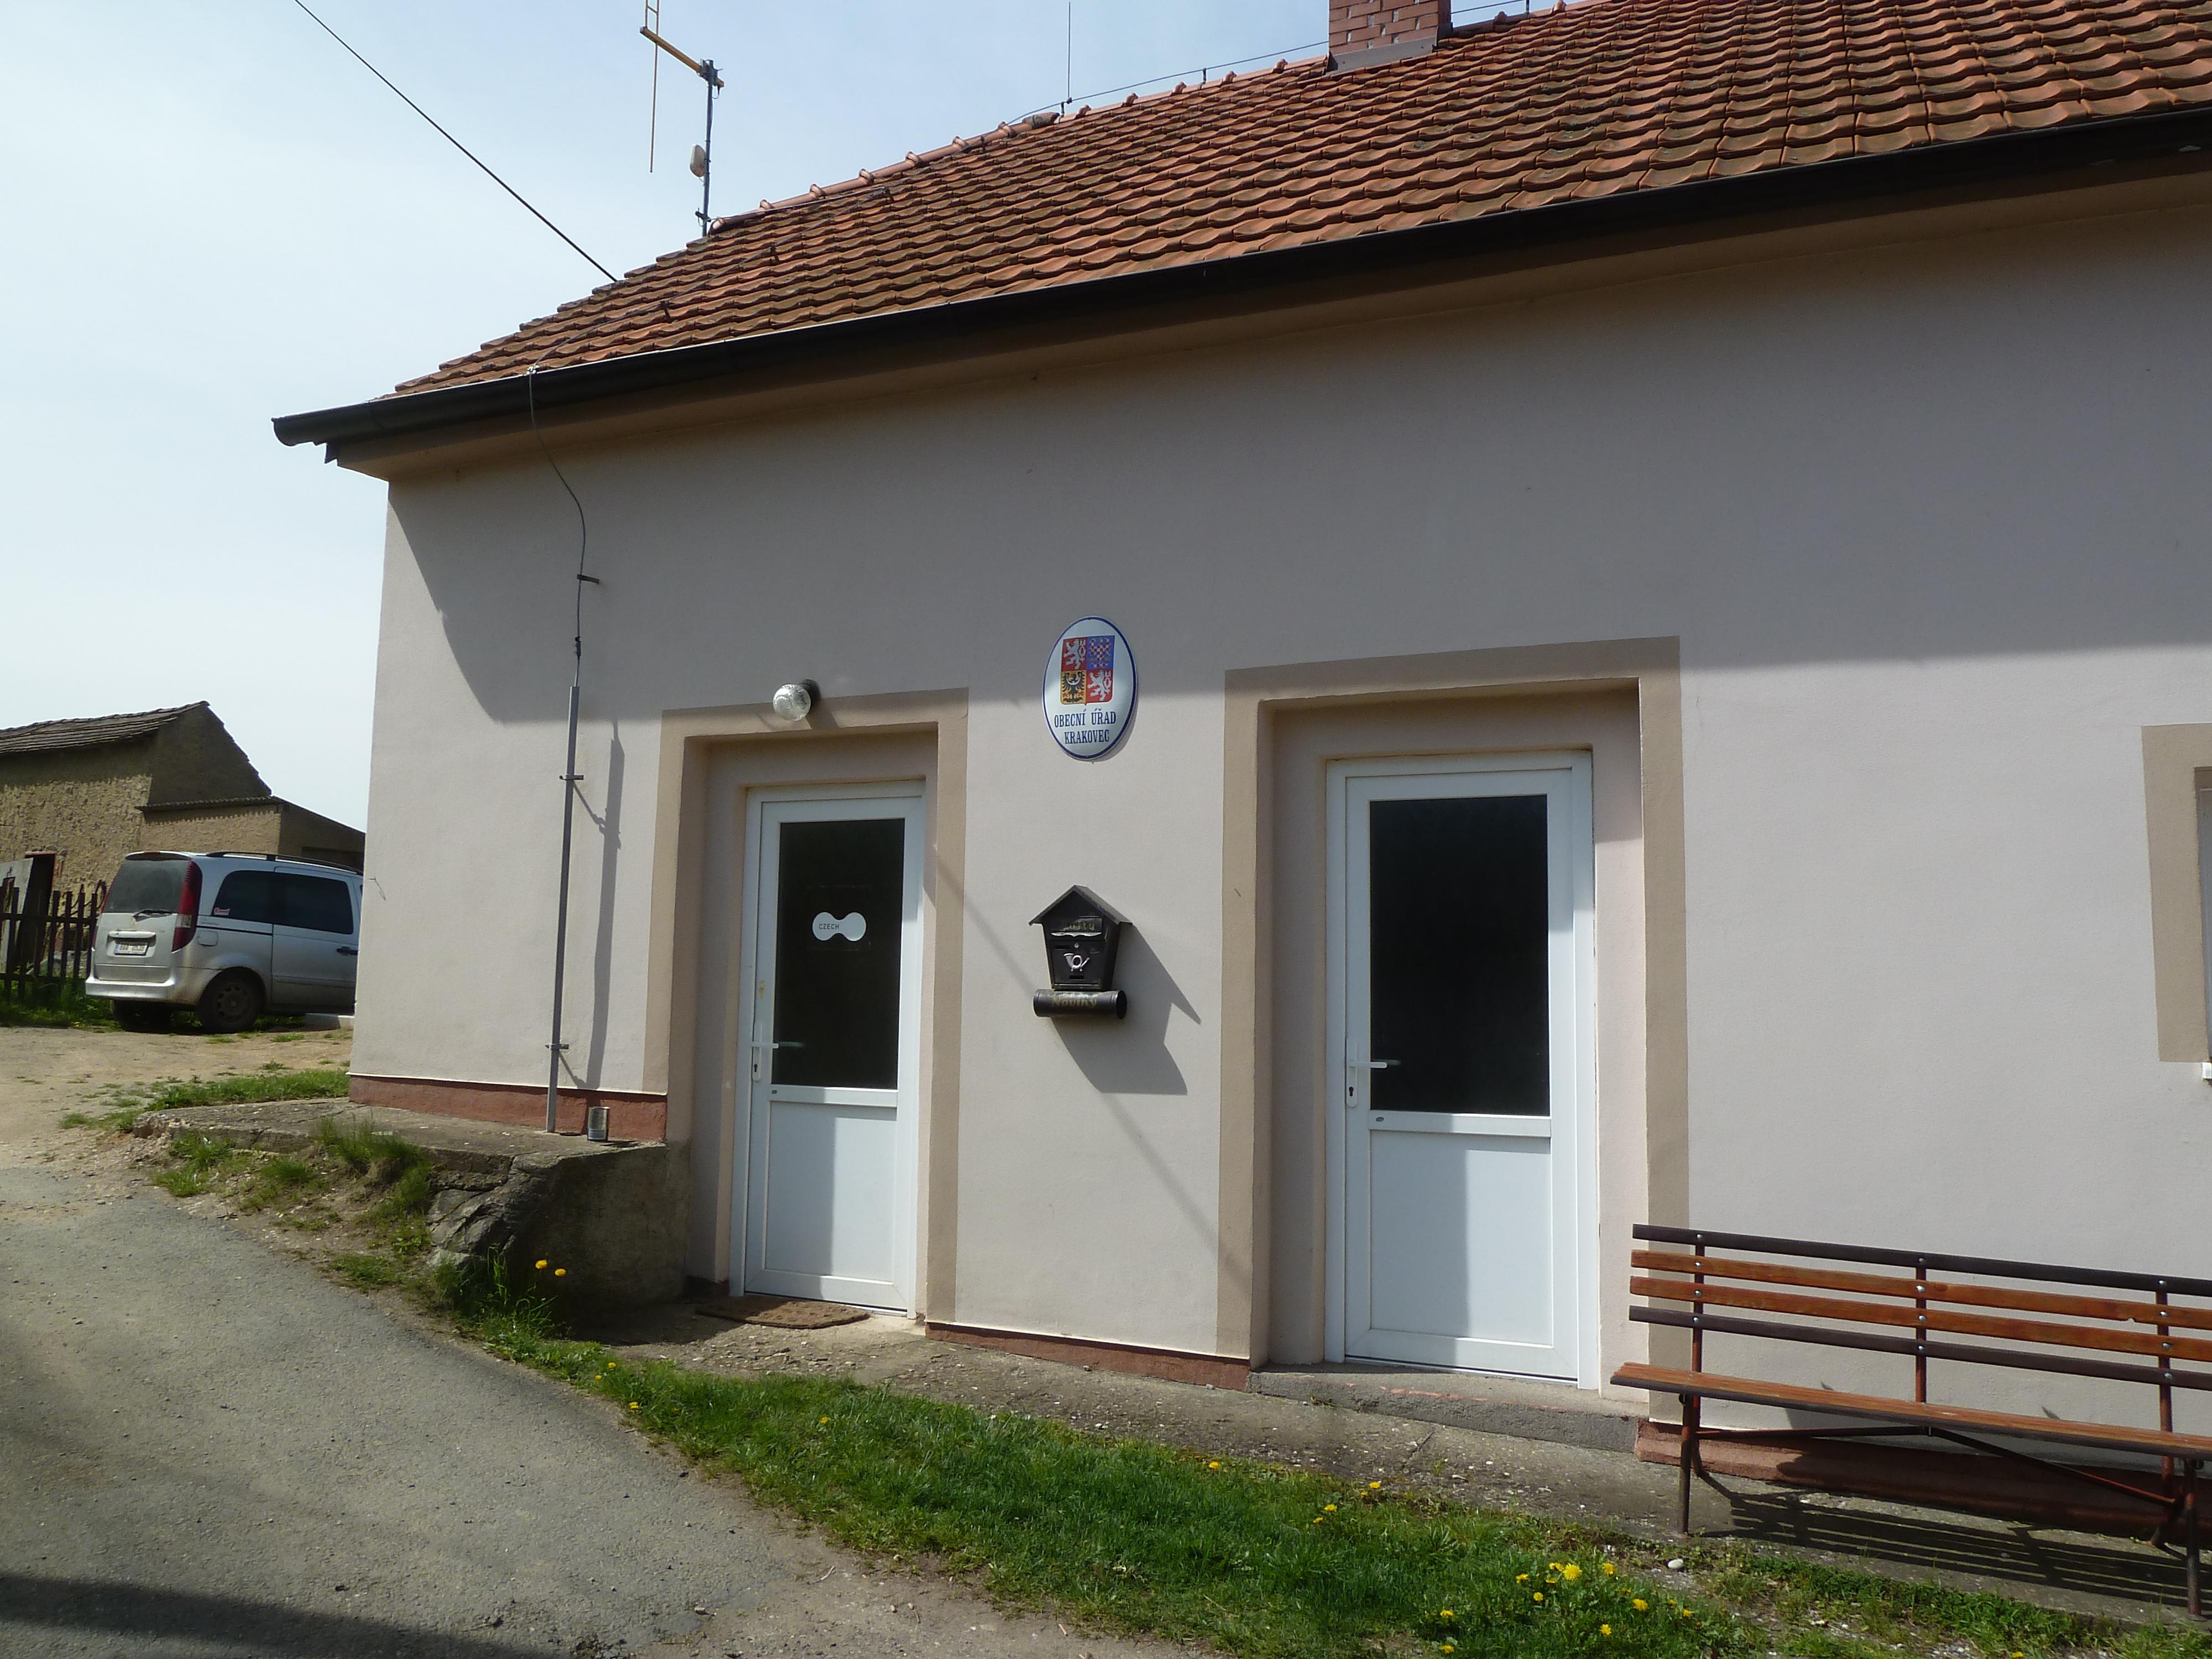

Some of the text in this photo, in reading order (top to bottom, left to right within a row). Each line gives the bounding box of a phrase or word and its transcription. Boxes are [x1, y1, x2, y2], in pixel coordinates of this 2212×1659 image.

[1054, 708, 1117, 728] OBECNÍ ÚŘAD
[1064, 729, 1110, 744] KRAKOVEC
